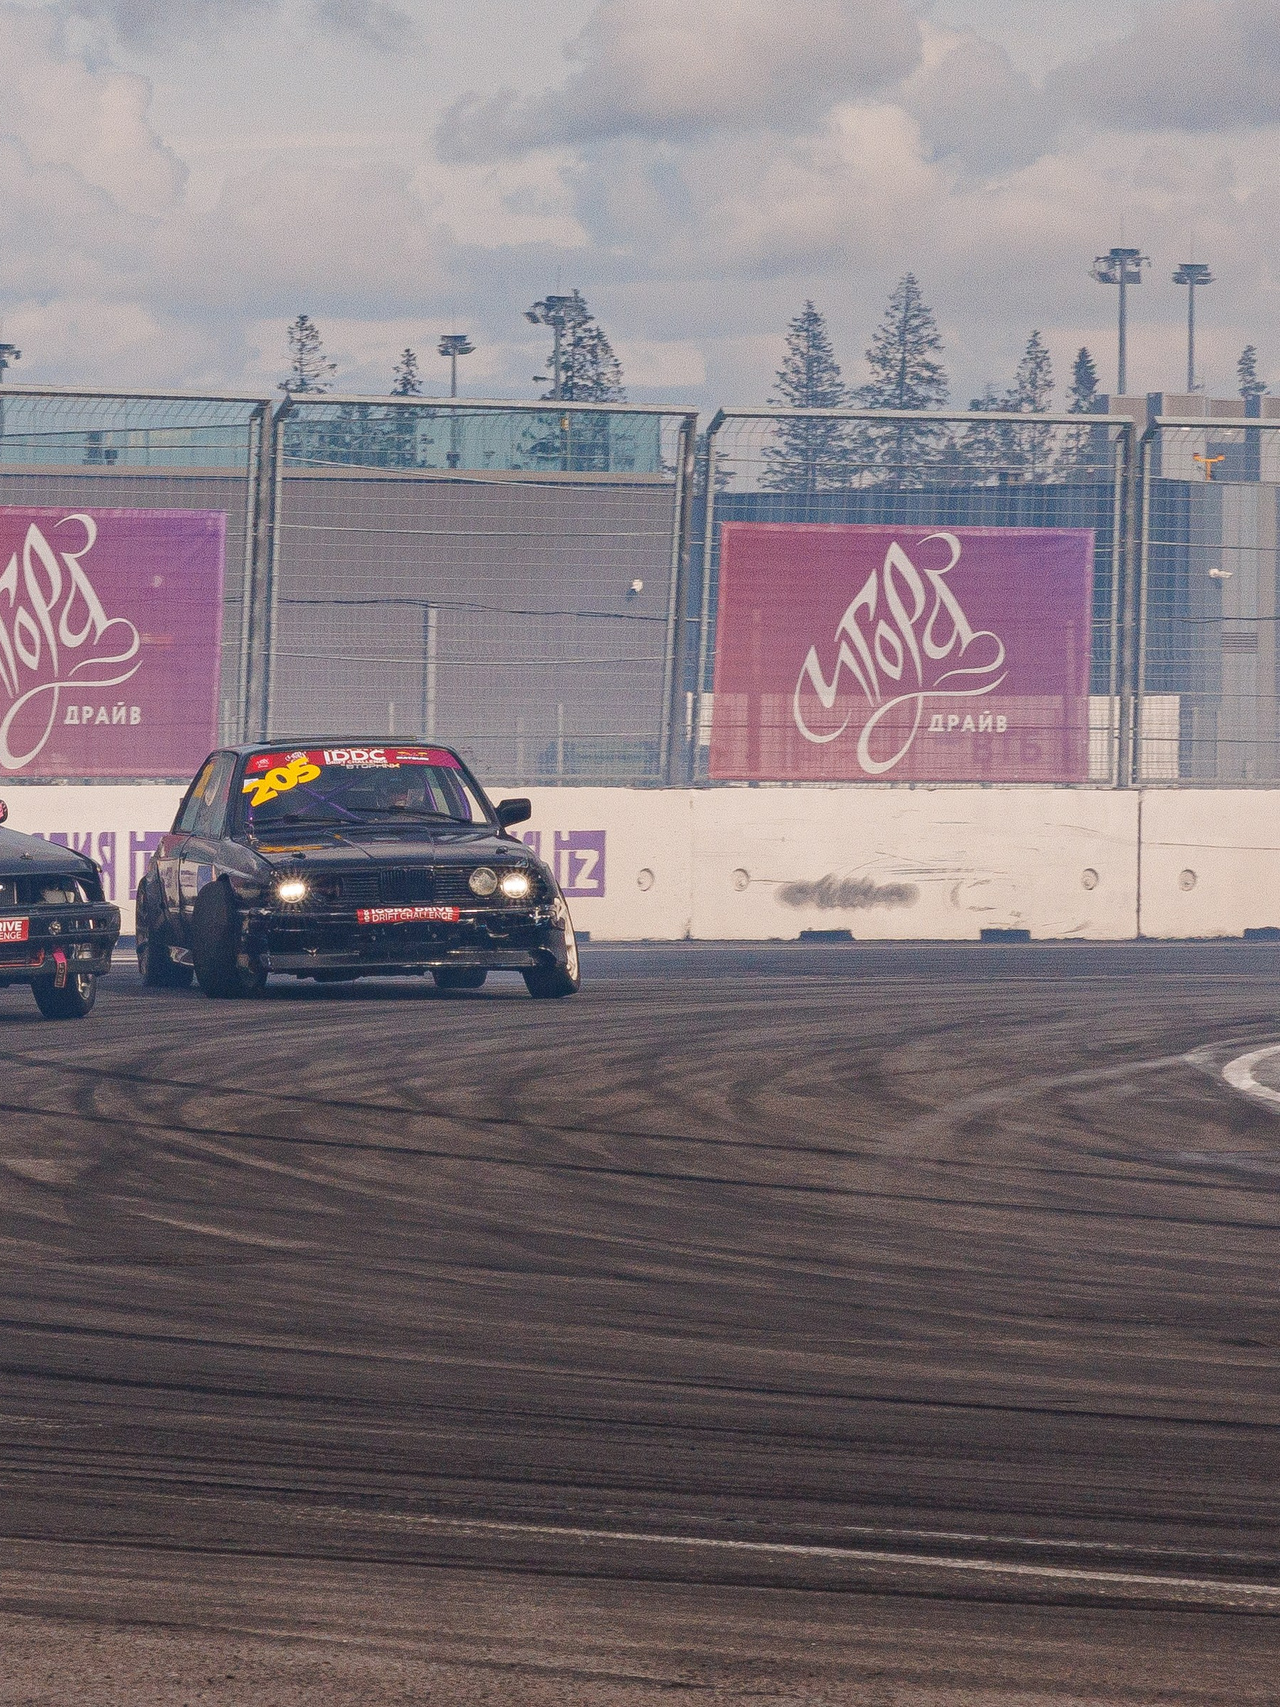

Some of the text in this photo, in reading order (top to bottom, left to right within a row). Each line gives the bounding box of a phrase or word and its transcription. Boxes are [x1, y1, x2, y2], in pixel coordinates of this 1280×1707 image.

[63, 702, 142, 725] ДРАЙВ
[927, 710, 1008, 733] ДРАЙВ
[323, 750, 386, 765] IDDC
[241, 757, 322, 807] 205
[372, 911, 453, 922] DRIFT CHALLENGE
